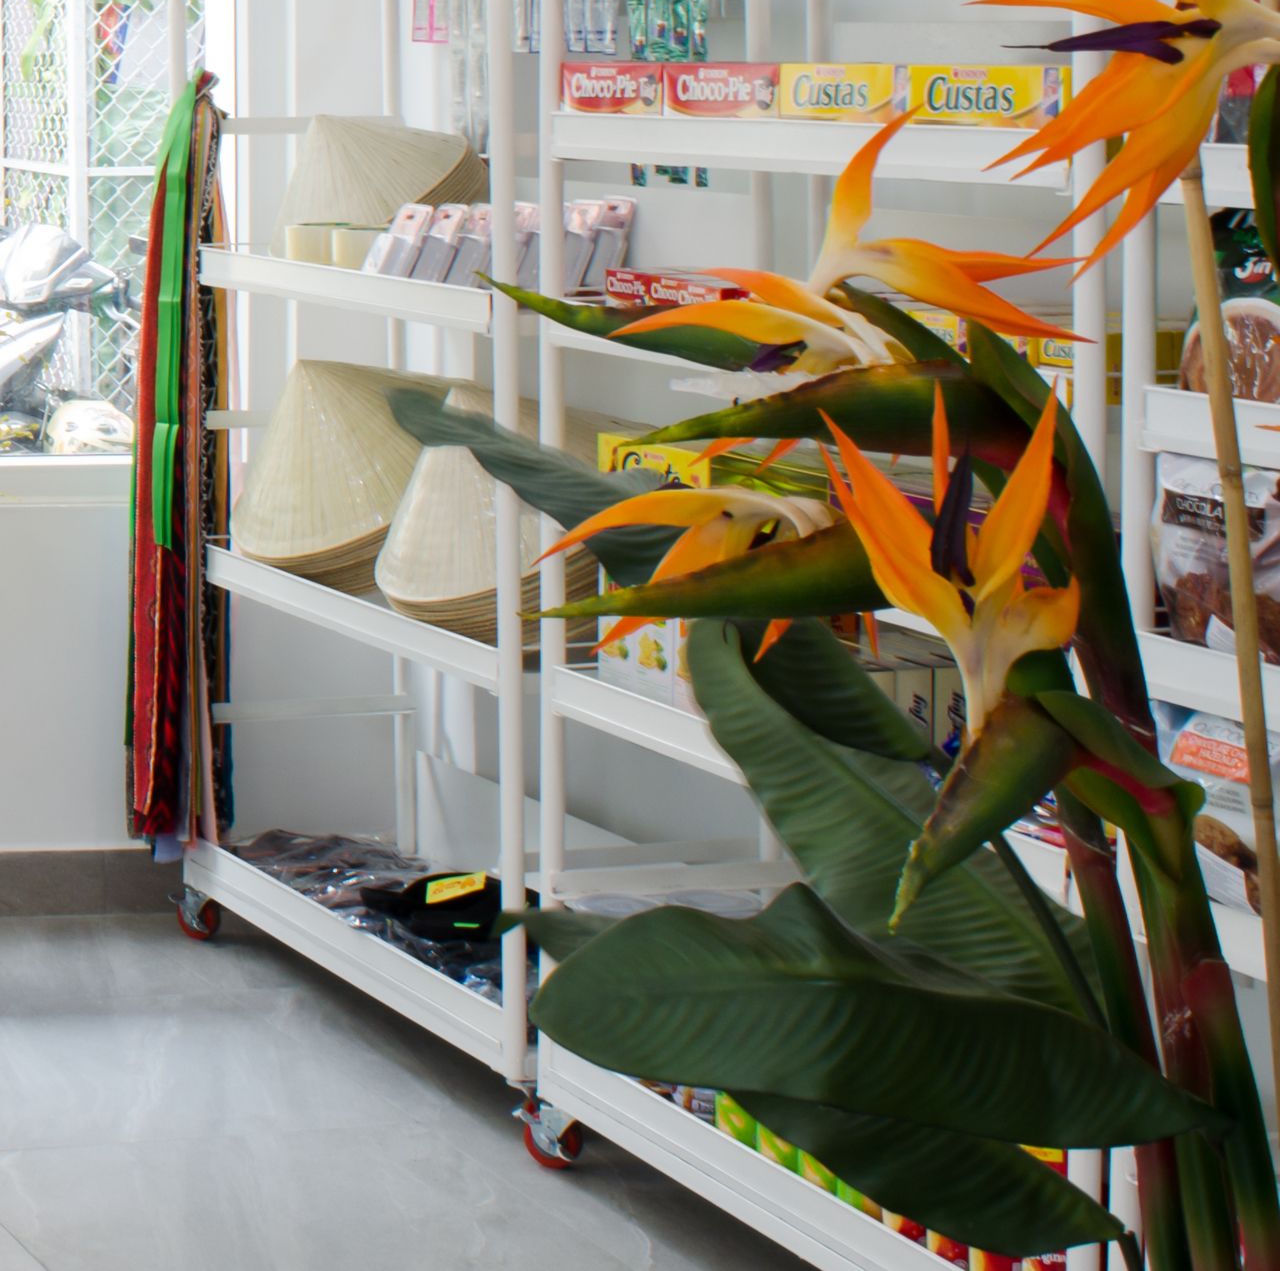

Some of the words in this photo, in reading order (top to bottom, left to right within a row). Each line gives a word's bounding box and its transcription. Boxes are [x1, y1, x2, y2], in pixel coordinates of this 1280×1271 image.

[794, 74, 868, 109] Custas
[928, 75, 1014, 113] Custas
[1176, 497, 1224, 519] CHOCOLA
